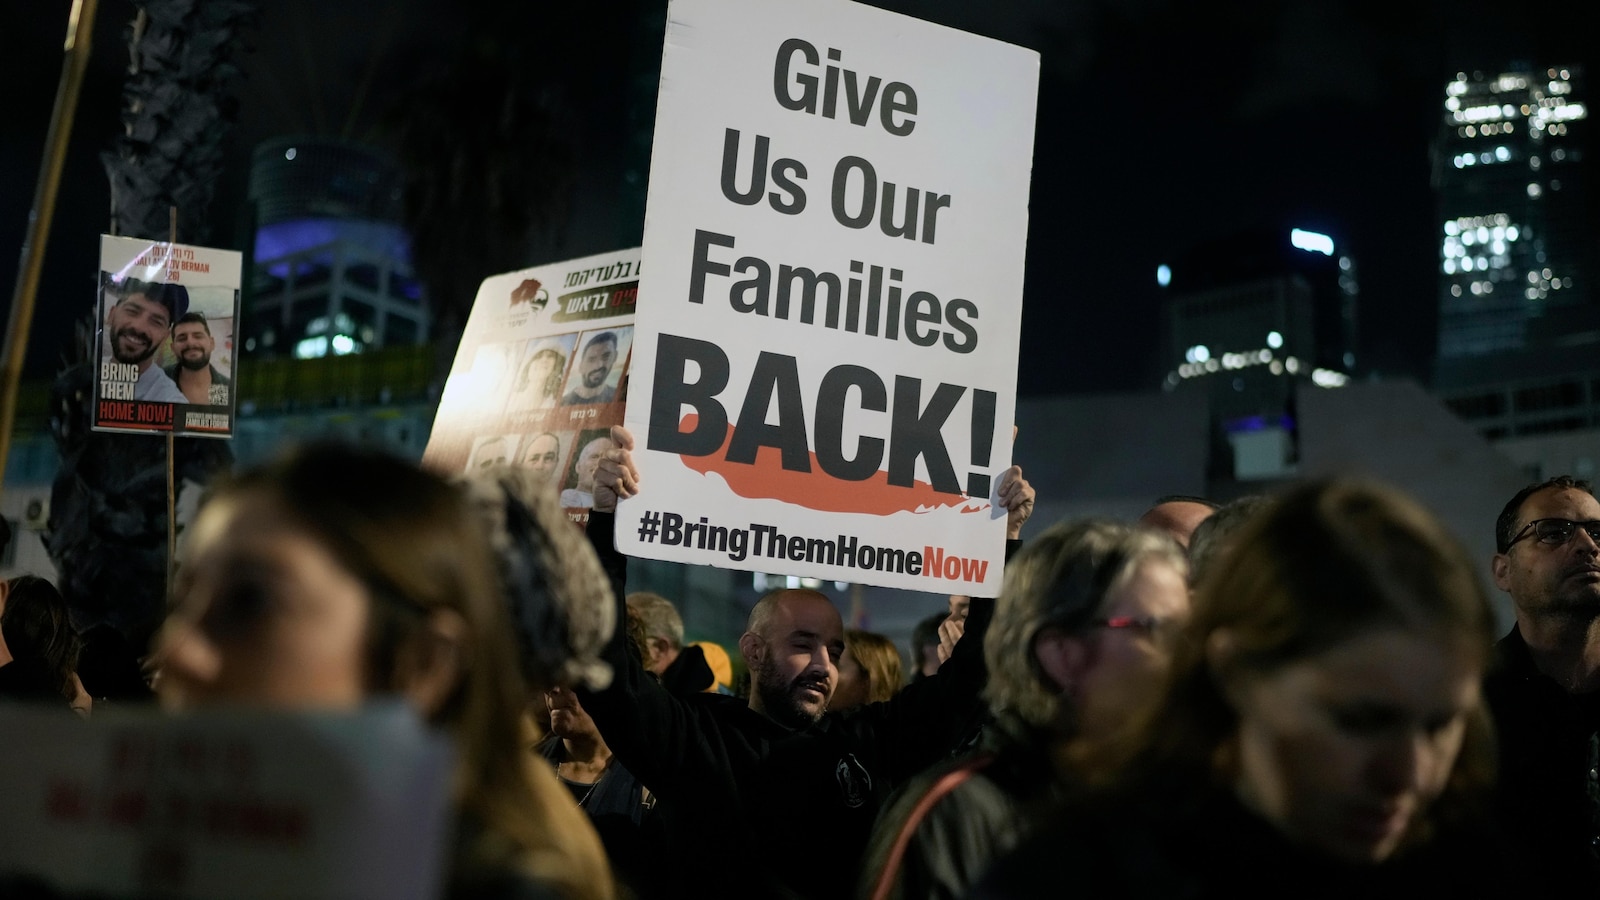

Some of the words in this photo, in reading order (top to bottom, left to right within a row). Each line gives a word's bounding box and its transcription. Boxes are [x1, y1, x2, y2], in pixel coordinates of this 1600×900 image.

[774, 38, 918, 137] Give
[720, 127, 808, 216] Us
[831, 155, 951, 245] Our
[181, 260, 210, 273] BERMAN
[563, 261, 632, 288] בלעדיהם!
[565, 292, 609, 314] בראש
[688, 228, 979, 354] Families
[101, 362, 139, 382] BRING
[100, 380, 135, 401] THEM
[99, 401, 135, 421] HOME
[137, 403, 174, 423] NOW!
[647, 333, 998, 500] BACK!
[638, 510, 989, 584] #BringThemHomeNow
